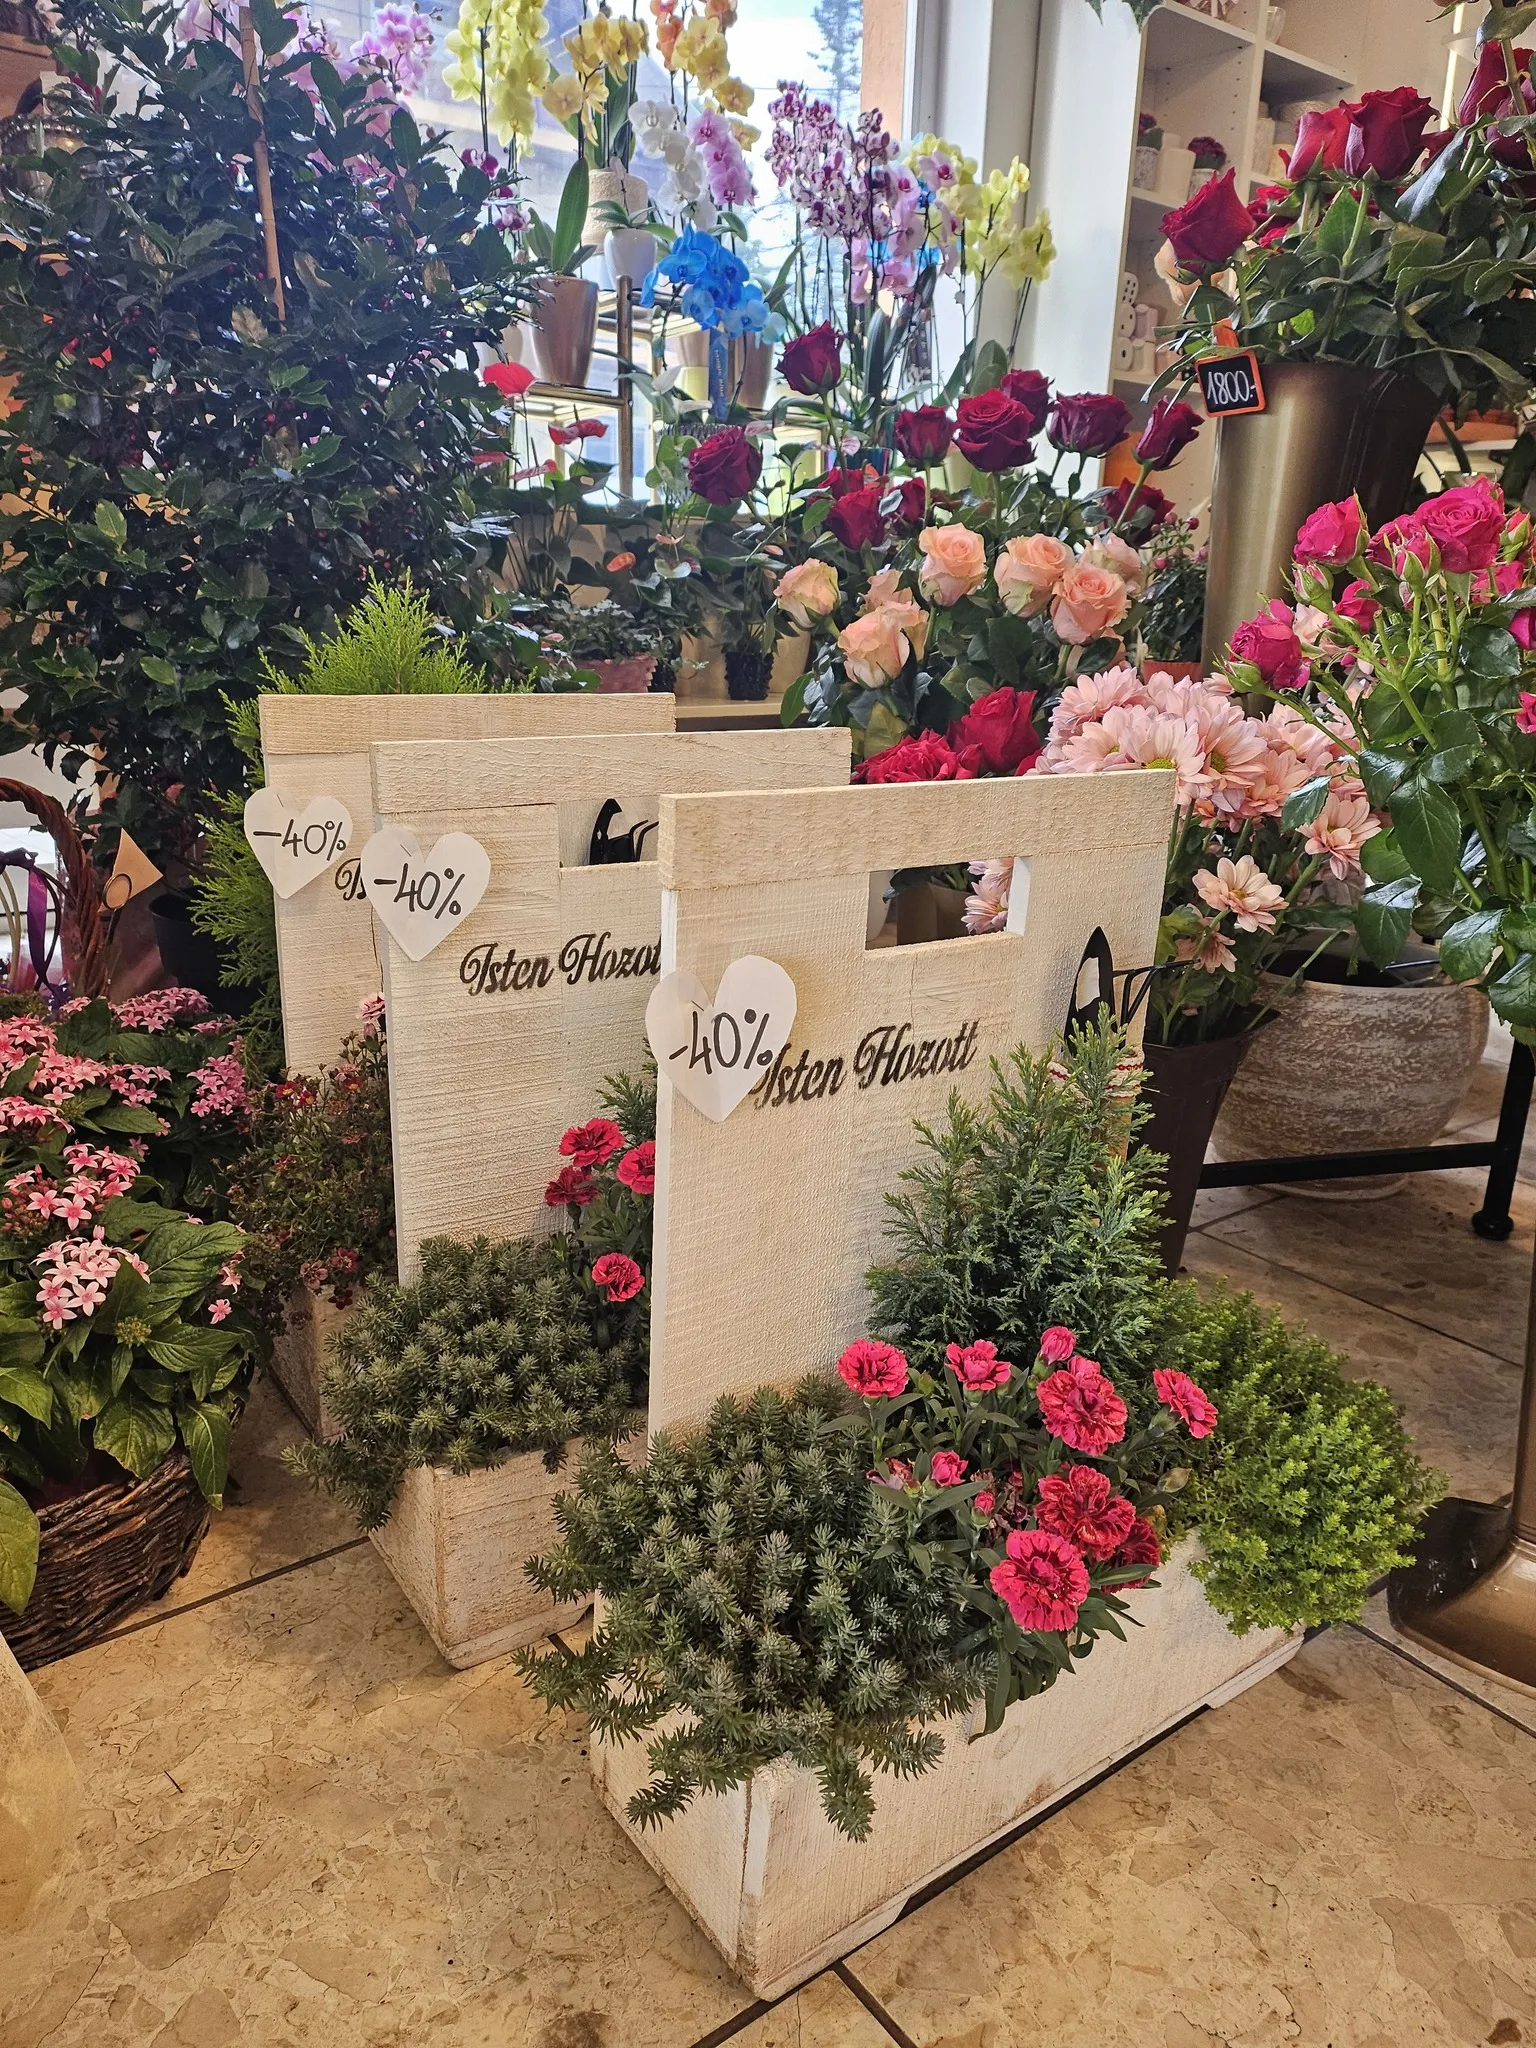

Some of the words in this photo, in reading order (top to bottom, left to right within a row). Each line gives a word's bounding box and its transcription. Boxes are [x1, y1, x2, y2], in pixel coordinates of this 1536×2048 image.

[253, 818, 347, 861] -40%
[373, 862, 466, 919] -40%
[459, 942, 555, 996] Isten
[668, 1008, 774, 1075] -40%
[853, 1017, 980, 1090] Hozott
